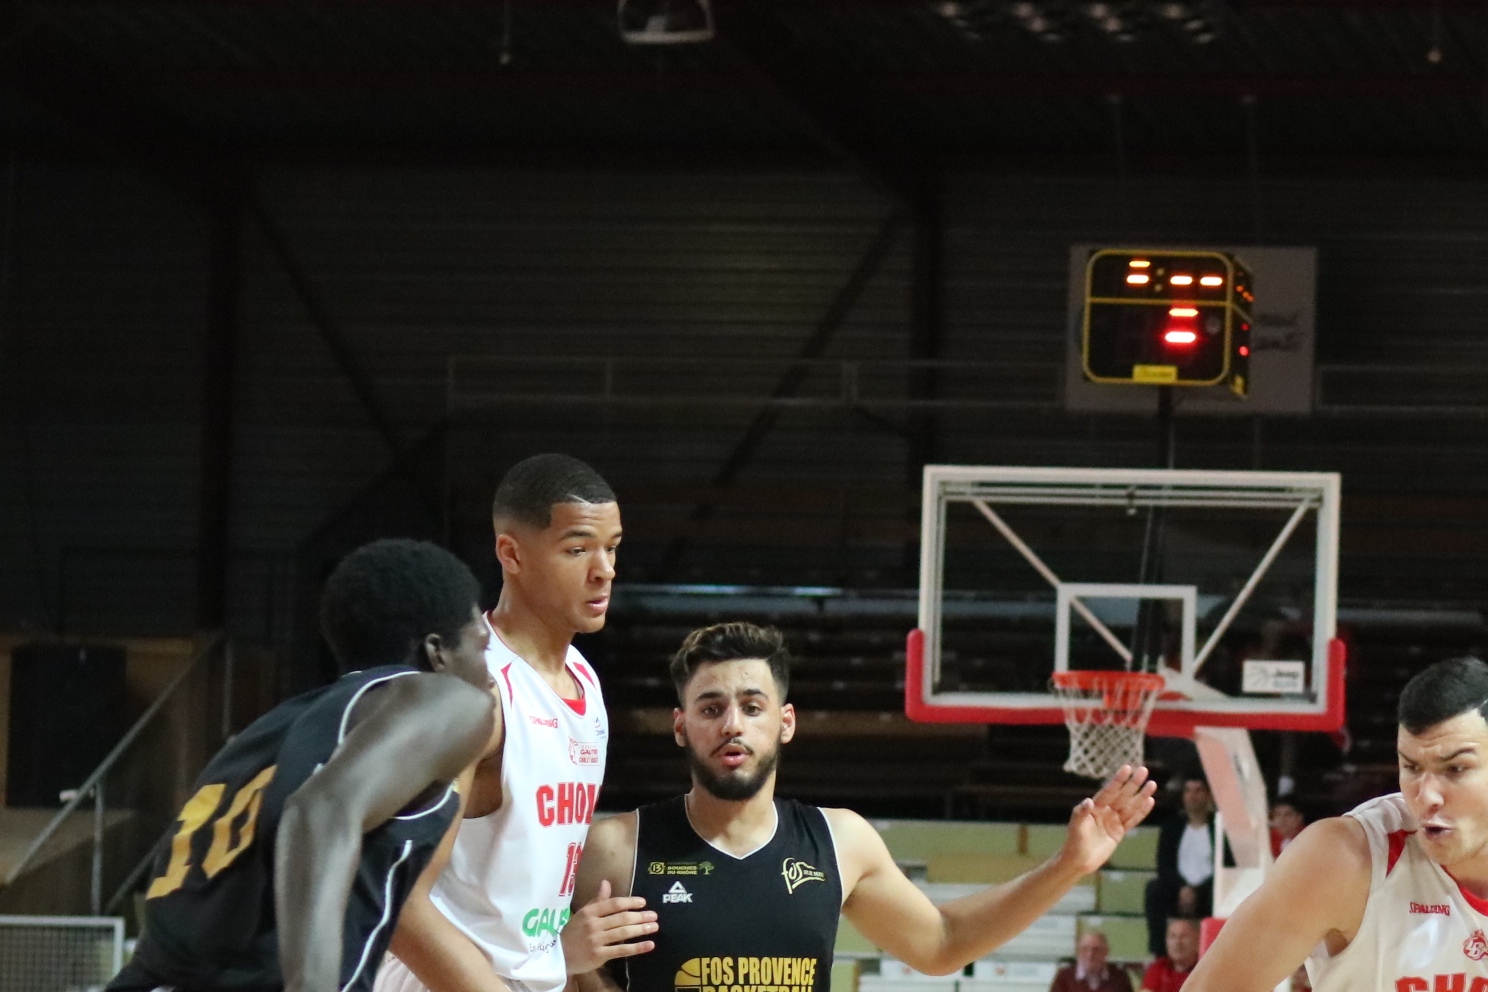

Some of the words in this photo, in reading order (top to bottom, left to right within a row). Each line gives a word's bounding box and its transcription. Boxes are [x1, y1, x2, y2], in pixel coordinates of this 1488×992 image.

[536, 782, 603, 828] CHOL
[146, 764, 278, 900] 10
[663, 893, 693, 904] PEAK
[1409, 902, 1450, 916] SPALDING
[702, 957, 735, 986] FOS
[738, 957, 817, 987] PROVENCE
